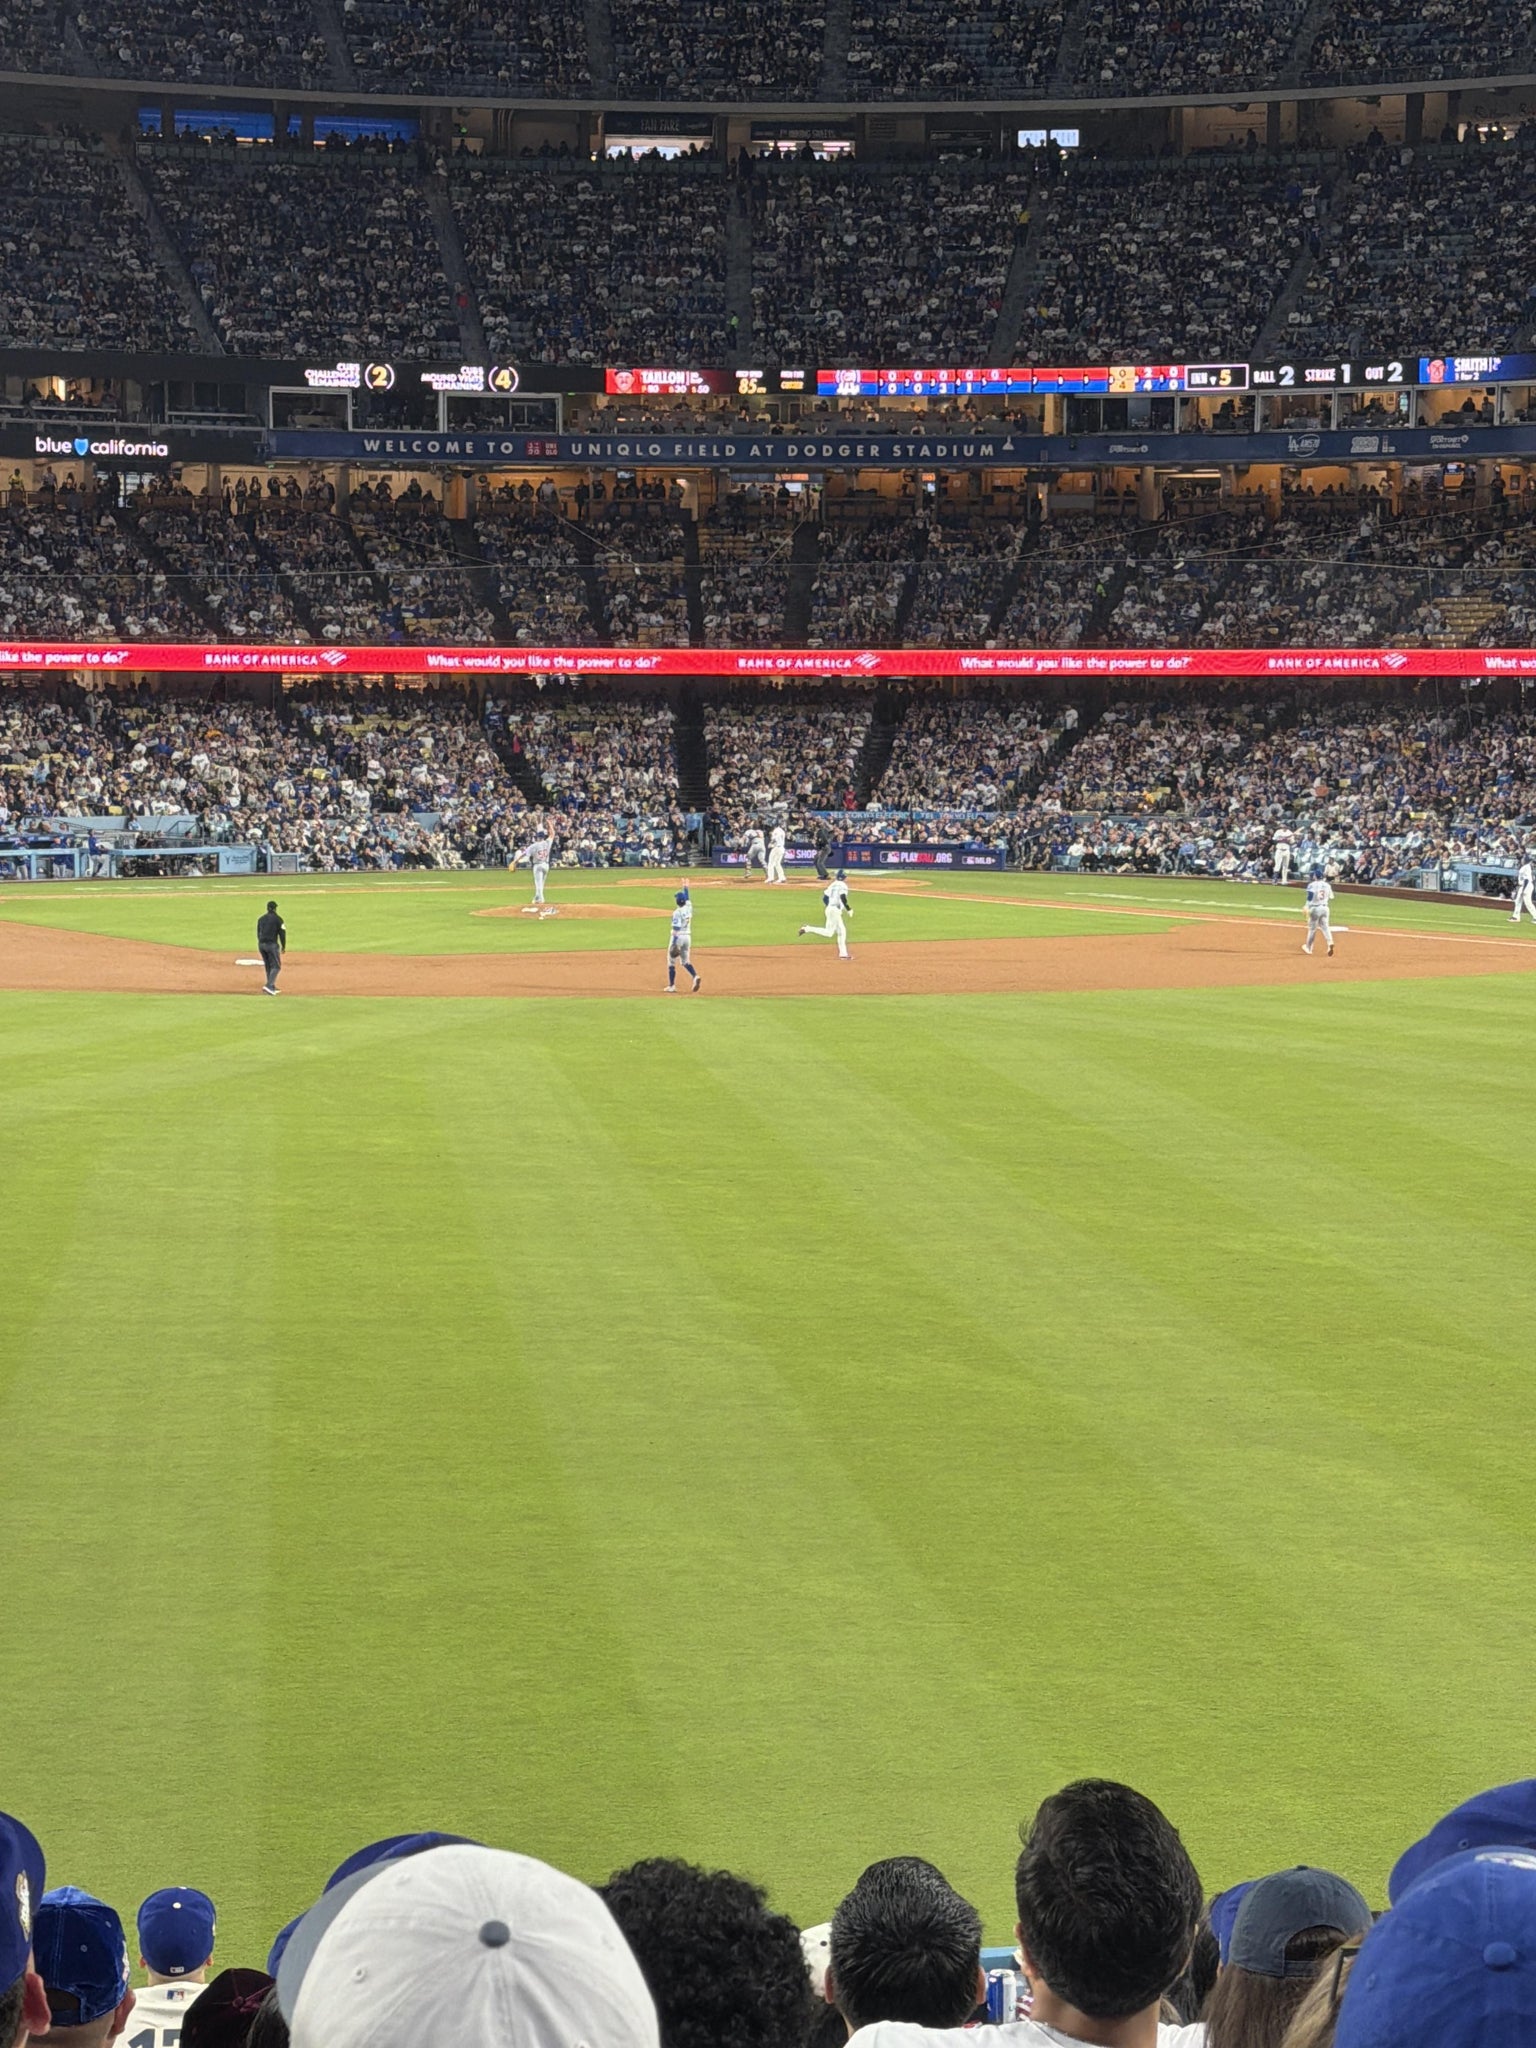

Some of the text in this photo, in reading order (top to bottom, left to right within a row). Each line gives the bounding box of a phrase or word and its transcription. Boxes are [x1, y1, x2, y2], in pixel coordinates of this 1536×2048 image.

[1364, 361, 1403, 382] OUT 2
[1453, 357, 1488, 372] SMITH
[641, 370, 686, 384] TAILLON
[888, 370, 897, 382] 0
[914, 370, 923, 382] 0
[939, 370, 948, 382] 0
[965, 369, 974, 382] 0
[991, 368, 1000, 381] 0
[1119, 369, 1126, 378] 0
[1218, 369, 1231, 386] 5
[1252, 366, 1295, 386] BALL 2
[1304, 363, 1351, 384] STRIKE 1
[738, 378, 757, 394] 85
[888, 382, 897, 394] 0
[913, 382, 922, 395] 0
[966, 382, 972, 394] 1
[1143, 379, 1152, 392] 4
[1168, 379, 1178, 390] 0
[36, 436, 168, 456] blue california
[363, 438, 514, 454] WELCOME TO
[571, 444, 994, 457] UNIQLO FIELD AT DODGER STADIUM
[22, 651, 42, 663] the
[45, 653, 84, 666] power
[86, 652, 99, 664] to
[205, 654, 318, 666] BANK OF AMERICA
[427, 655, 460, 667] What
[463, 655, 500, 668] would
[502, 658, 525, 670] you
[528, 655, 551, 668] like
[554, 656, 574, 668] the
[577, 658, 616, 670] power
[618, 657, 632, 668] to
[738, 658, 852, 669] BANK OF AMERICA
[961, 657, 994, 669] What
[996, 657, 1034, 669] would
[1036, 659, 1059, 671] you
[1061, 656, 1083, 669] like
[1086, 657, 1107, 669] the
[1109, 659, 1148, 672] power
[1150, 657, 1164, 669] to
[1268, 658, 1380, 669] BANK OF AMERICA
[1485, 656, 1517, 669] What
[796, 849, 817, 859] SHOP
